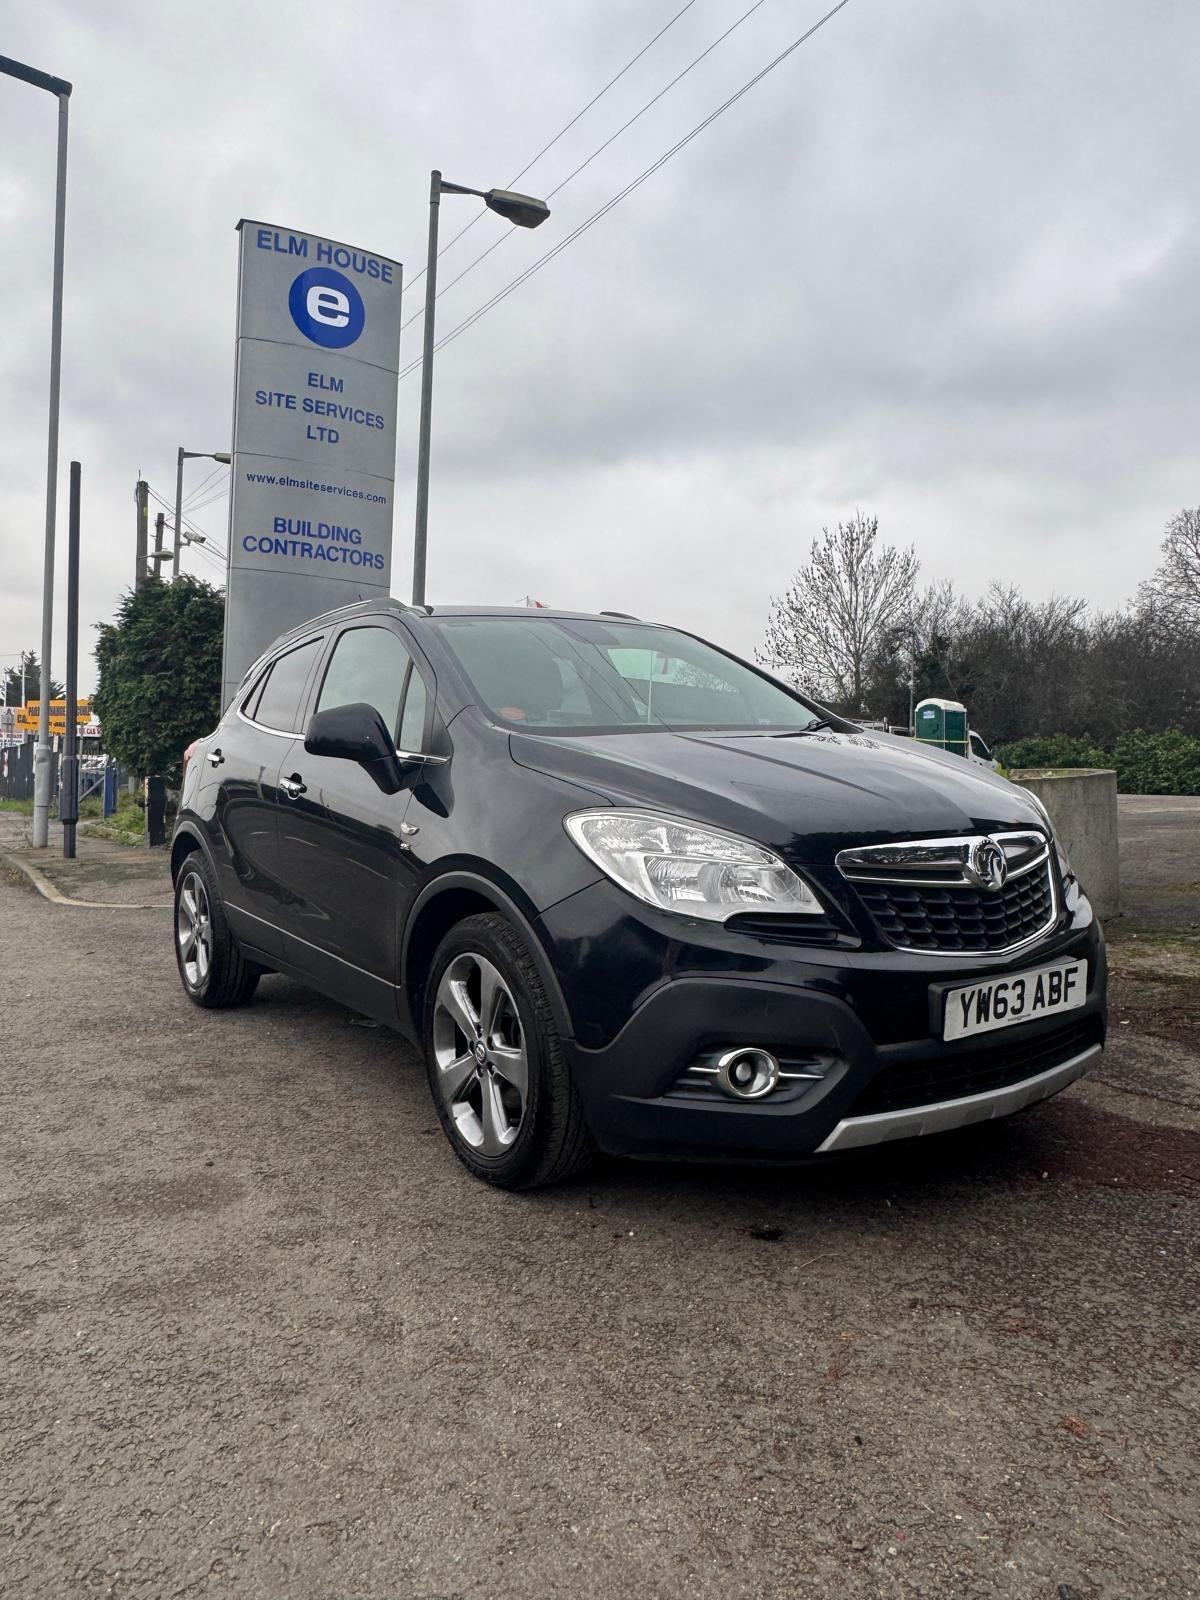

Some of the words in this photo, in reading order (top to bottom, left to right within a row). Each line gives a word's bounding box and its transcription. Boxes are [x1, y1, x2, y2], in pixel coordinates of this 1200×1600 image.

[257, 229, 308, 258] ELM
[316, 242, 393, 284] HOUSE
[306, 285, 350, 328] e
[307, 372, 344, 394] ELM
[255, 390, 297, 410] SITE
[302, 397, 385, 430] SERVICES
[306, 425, 340, 444] LTD
[246, 473, 387, 504] www.elmsiteservices.com
[273, 517, 362, 545] BUILDING
[242, 535, 385, 570] CONTRACTORS
[960, 979, 1026, 1029] YW63
[1032, 966, 1079, 1011] ABF
